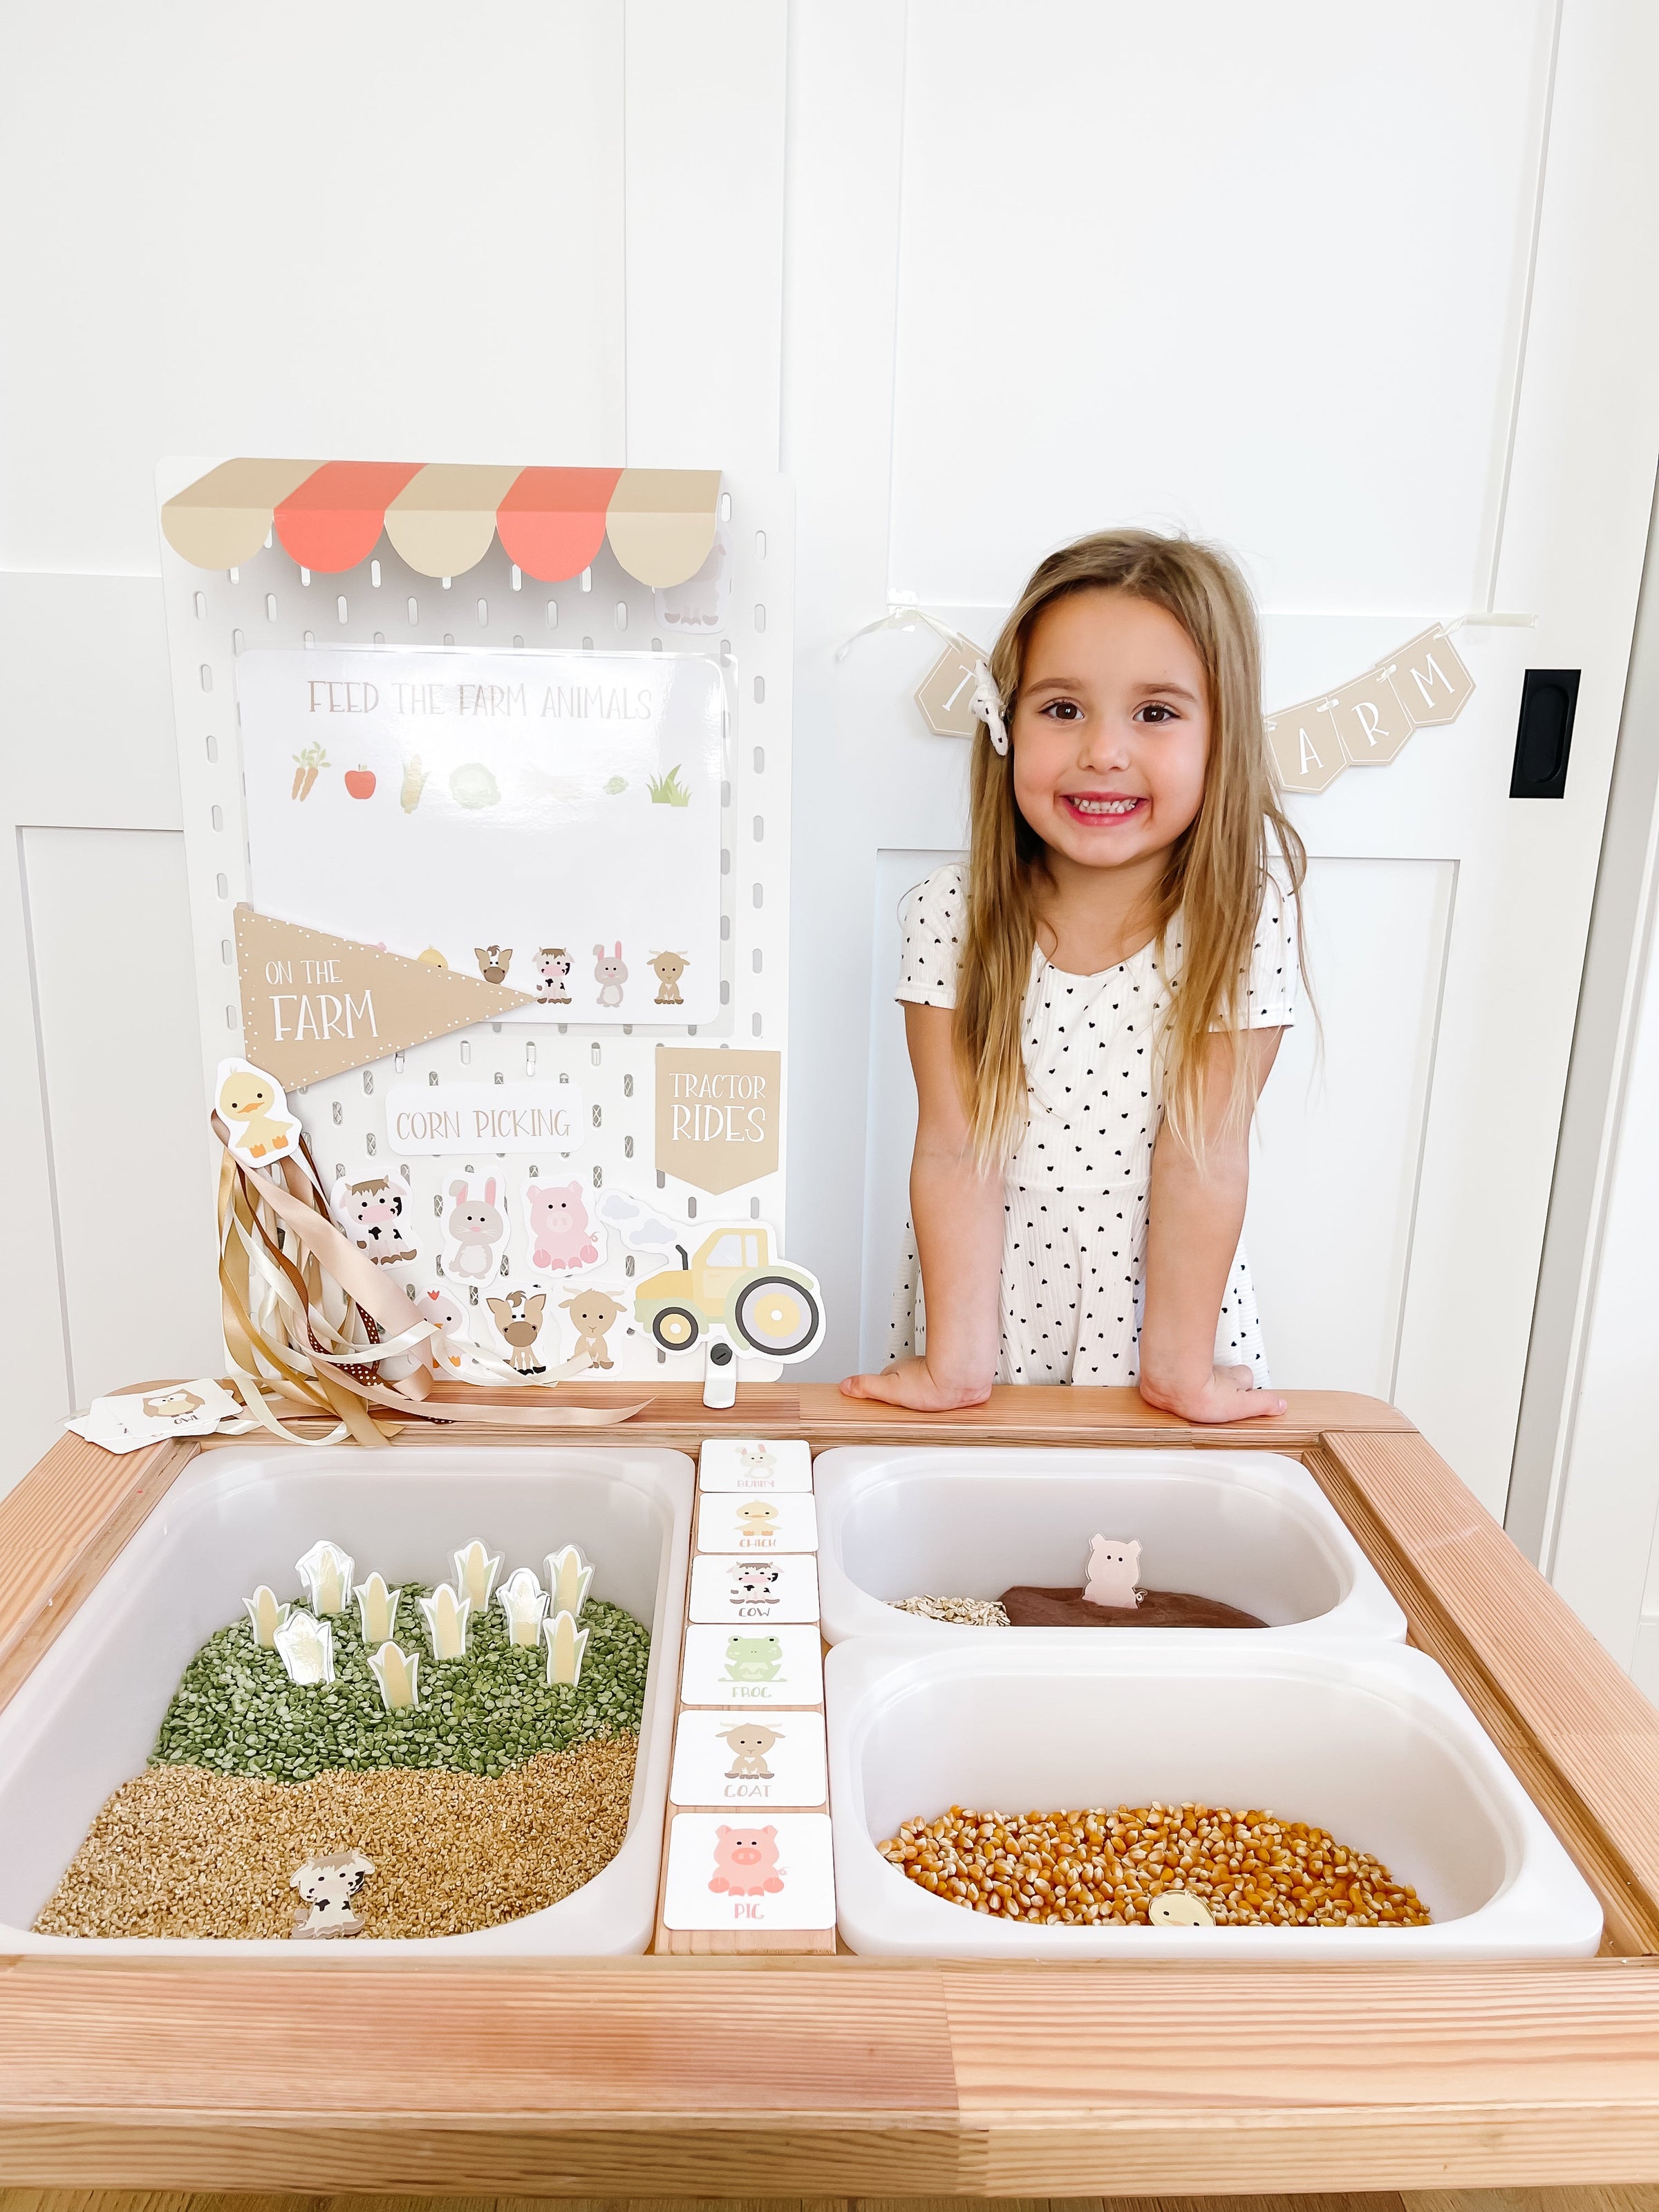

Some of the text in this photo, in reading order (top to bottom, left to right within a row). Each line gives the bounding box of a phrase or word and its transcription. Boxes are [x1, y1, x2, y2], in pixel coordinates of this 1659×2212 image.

[308, 680, 652, 720] FEED THE FARM ANIMALS
[1299, 653, 1456, 775] ARM
[265, 959, 343, 985] ON THE
[268, 990, 379, 1042] FARM
[669, 1073, 766, 1100] TRACTOR
[396, 1109, 571, 1140] CORN PICKING
[670, 1104, 767, 1143] RIDES
[174, 1414, 200, 1425] OWL
[739, 1539, 776, 1548] CHICK
[738, 1607, 770, 1618] COW
[731, 1687, 772, 1698] FROG
[724, 1785, 771, 1798] GOAT
[734, 1903, 765, 1920] PIG
